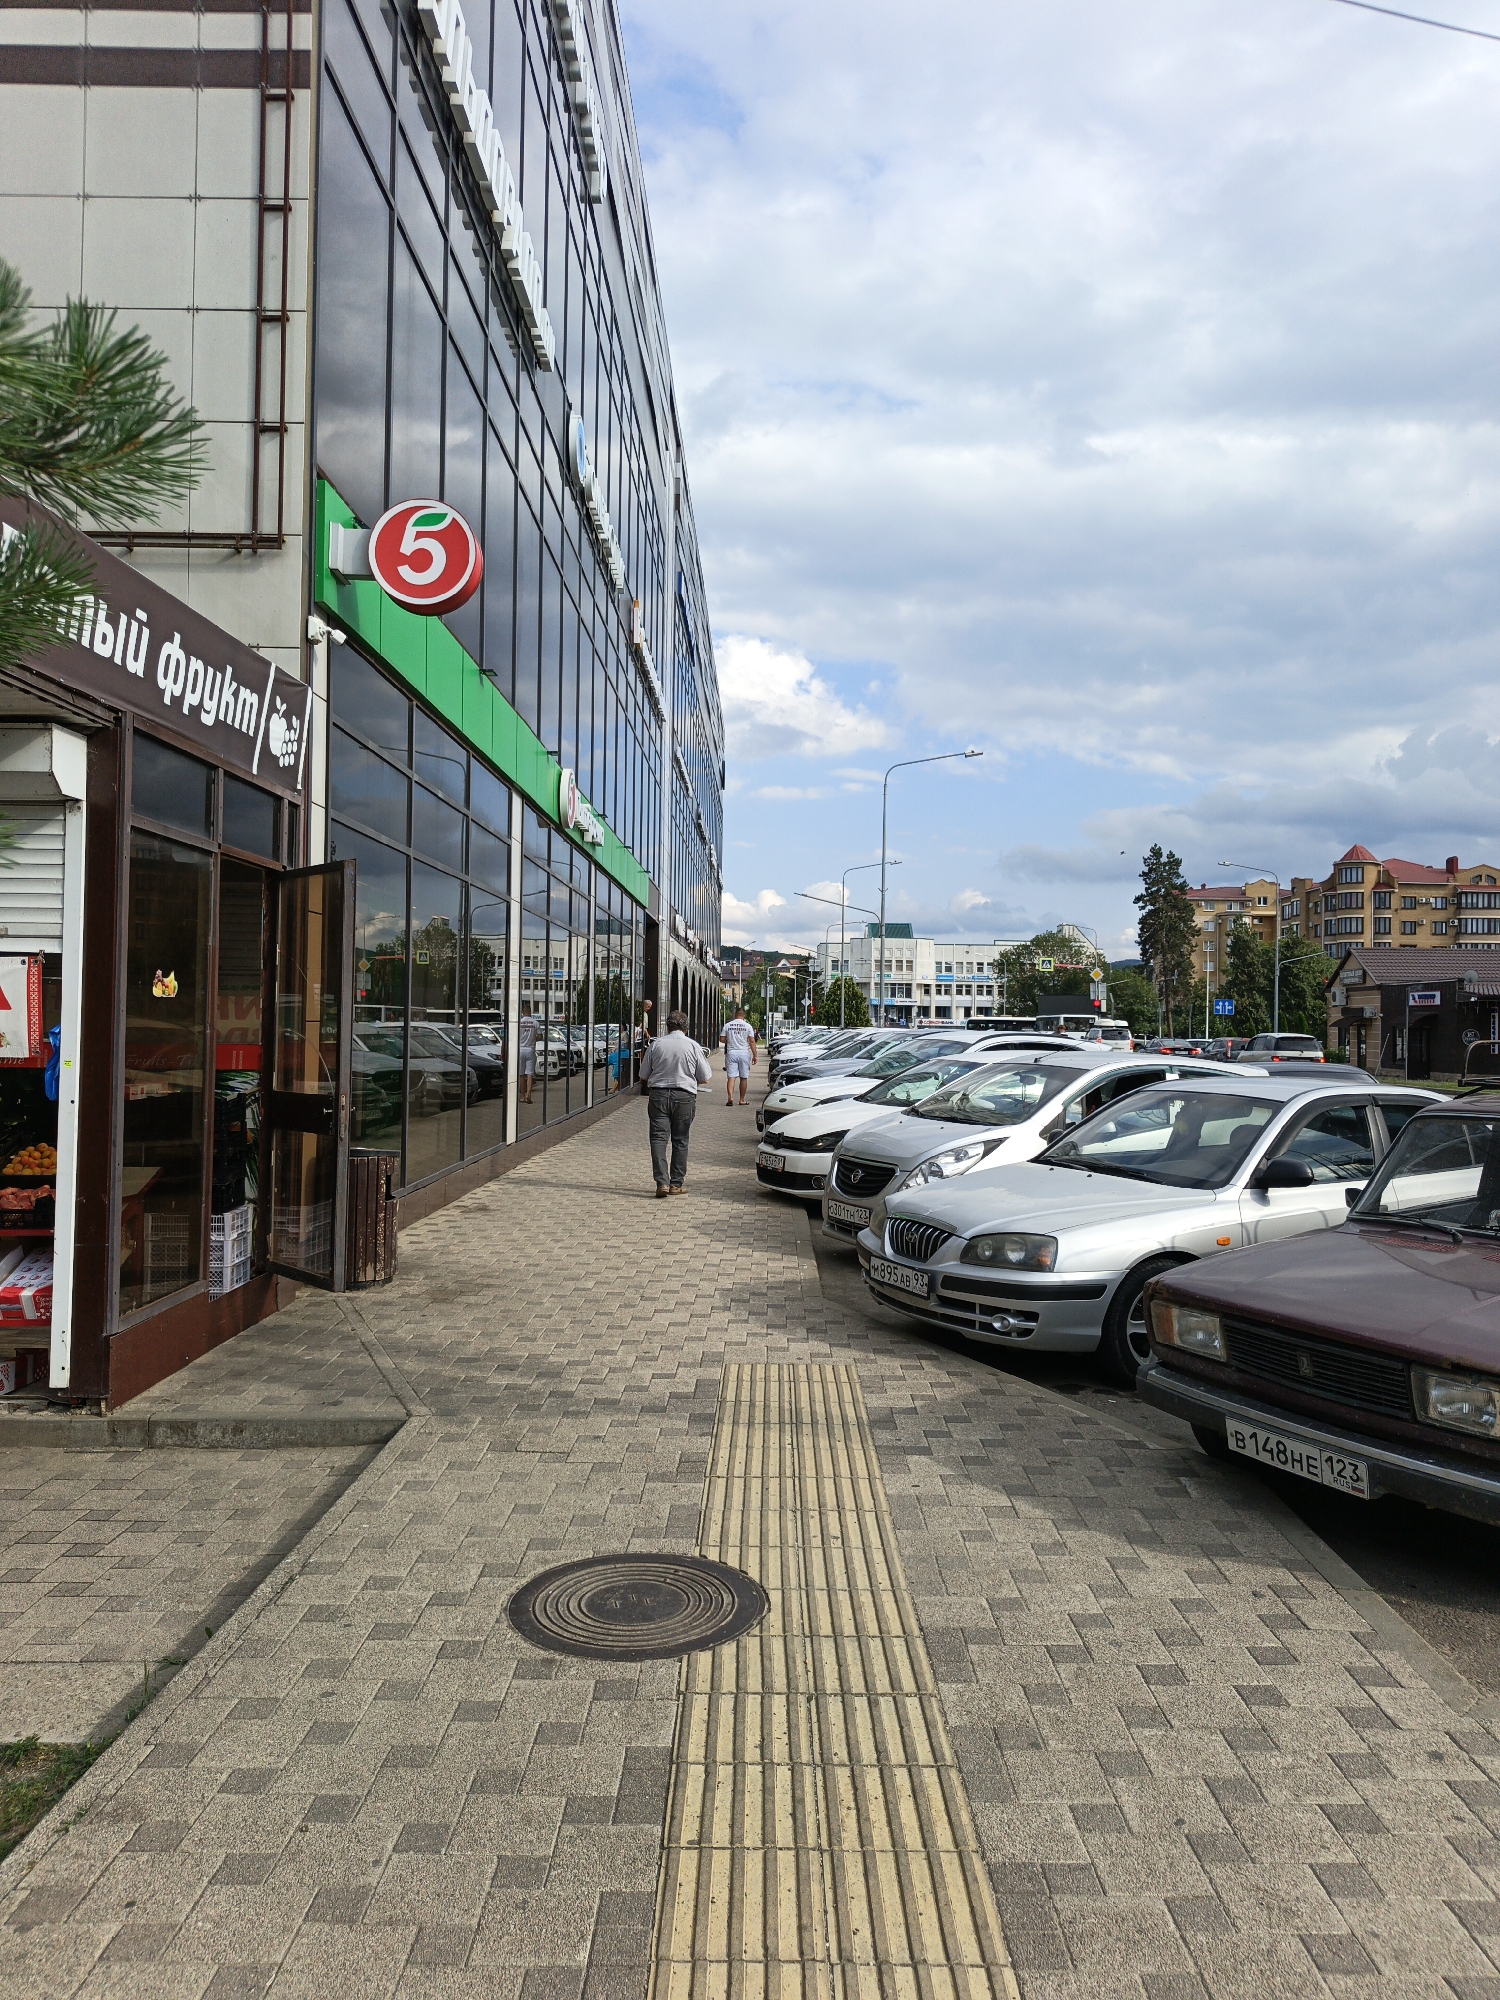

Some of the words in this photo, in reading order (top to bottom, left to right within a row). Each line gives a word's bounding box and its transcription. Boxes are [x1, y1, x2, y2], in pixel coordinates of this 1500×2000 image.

[397, 511, 448, 585] 5
[156, 631, 260, 738] фрукт
[873, 1263, 911, 1287] М895АВ
[913, 1272, 925, 1287] 93
[1234, 1428, 1320, 1478] В148НЕ
[1325, 1453, 1361, 1483] 123
[1333, 1476, 1351, 1490] RUS
